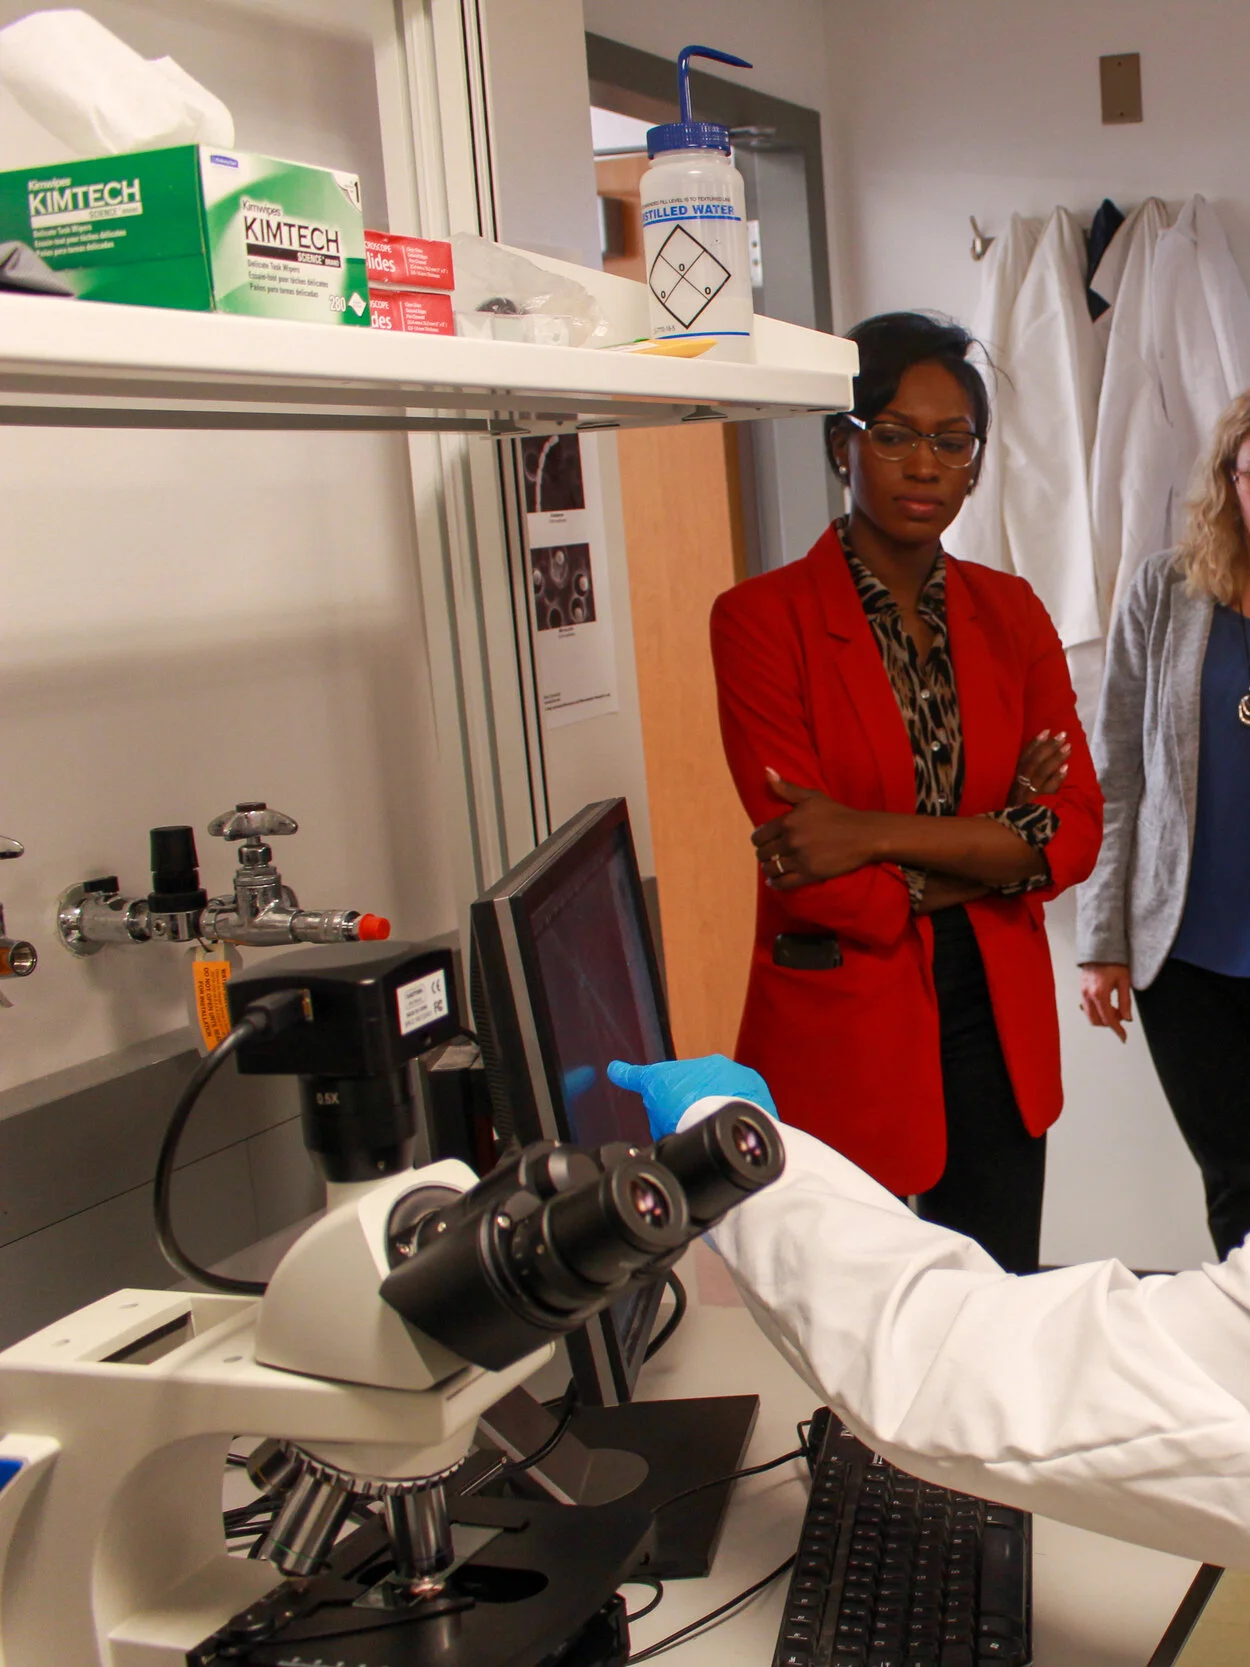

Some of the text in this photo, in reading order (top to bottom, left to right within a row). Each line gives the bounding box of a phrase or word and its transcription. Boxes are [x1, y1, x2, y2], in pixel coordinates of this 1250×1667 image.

[28, 178, 141, 215] KIMTECH
[242, 199, 282, 217] Kimwipes
[692, 204, 735, 215] WATER
[244, 215, 340, 254] KIMTECH
[366, 251, 396, 273] lides
[679, 264, 685, 272] 0
[661, 291, 666, 299] 0
[705, 287, 711, 295] 0
[329, 294, 347, 313] 280
